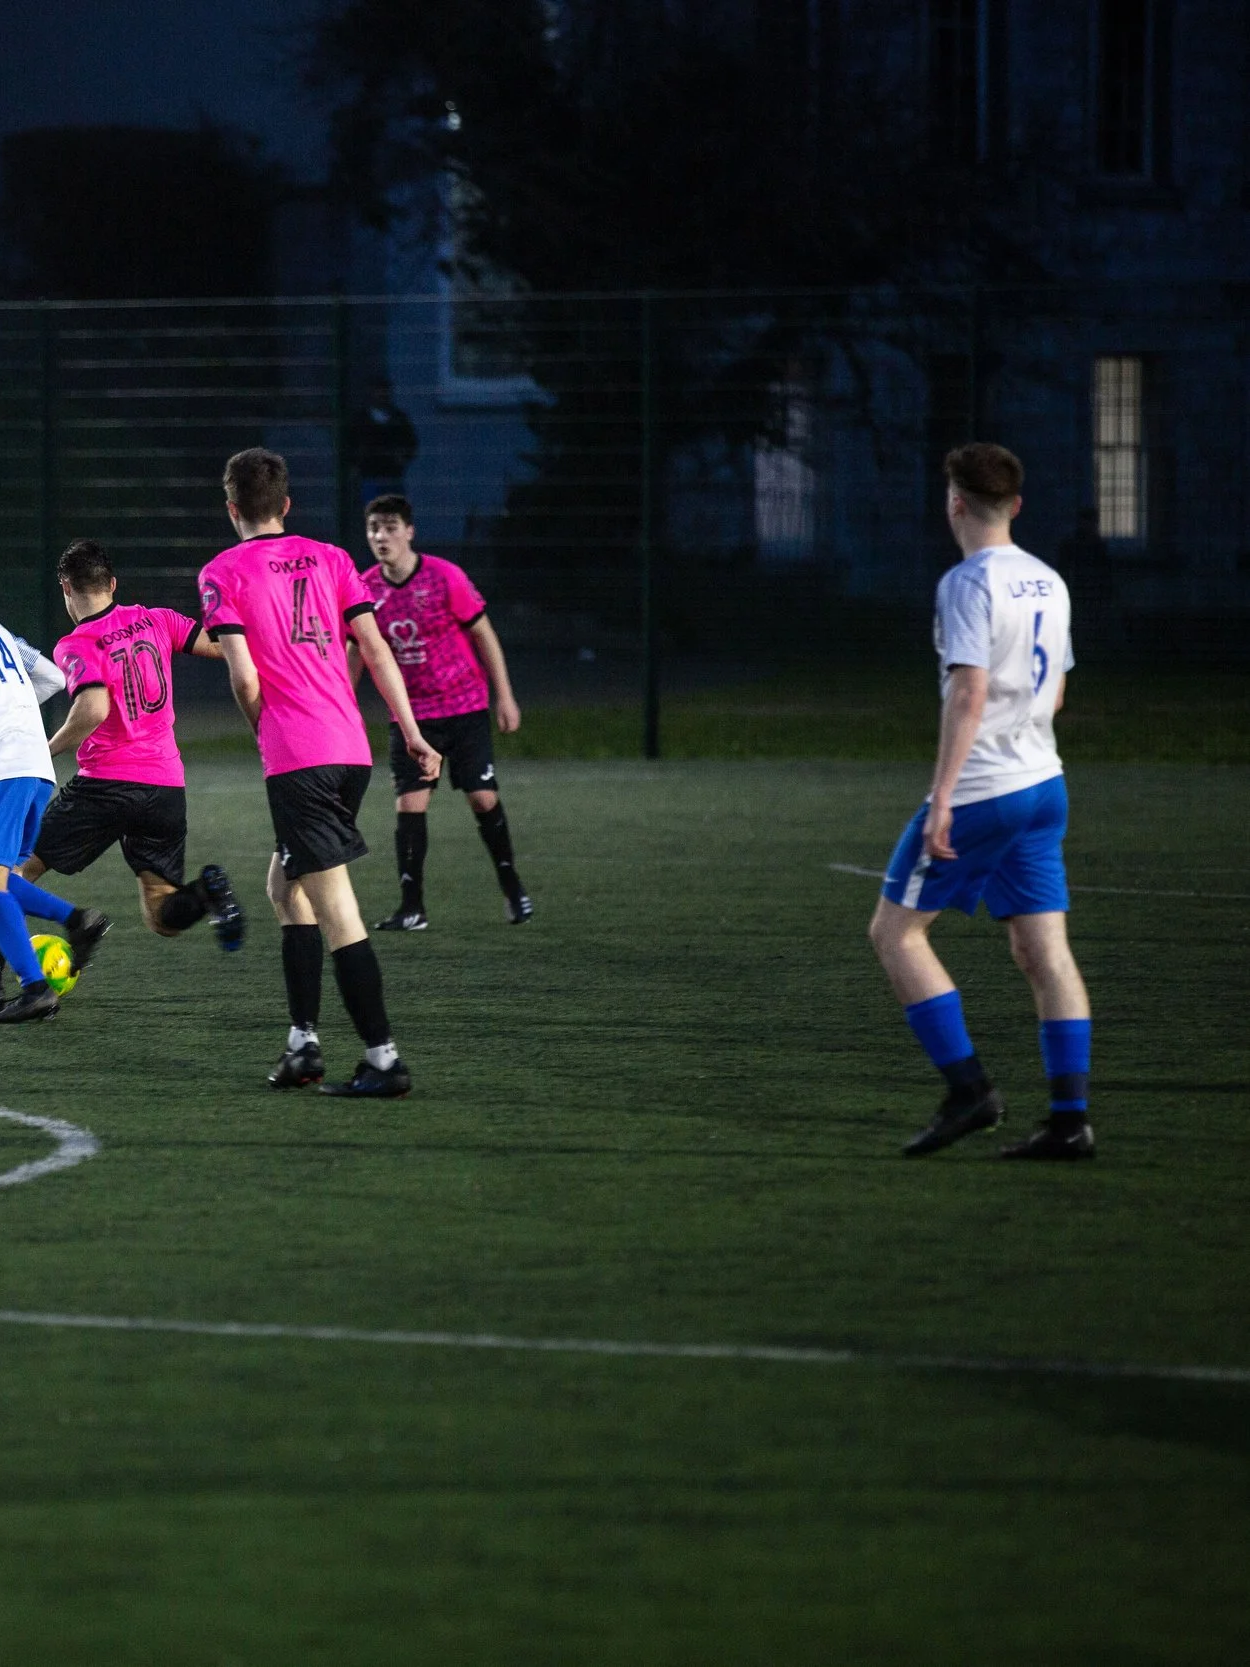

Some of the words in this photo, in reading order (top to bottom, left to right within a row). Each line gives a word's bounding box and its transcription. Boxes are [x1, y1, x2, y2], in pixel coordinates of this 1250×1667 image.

[269, 555, 318, 574] OWEN
[291, 577, 332, 660] 4
[1031, 611, 1048, 696] 6
[109, 639, 168, 722] 10
